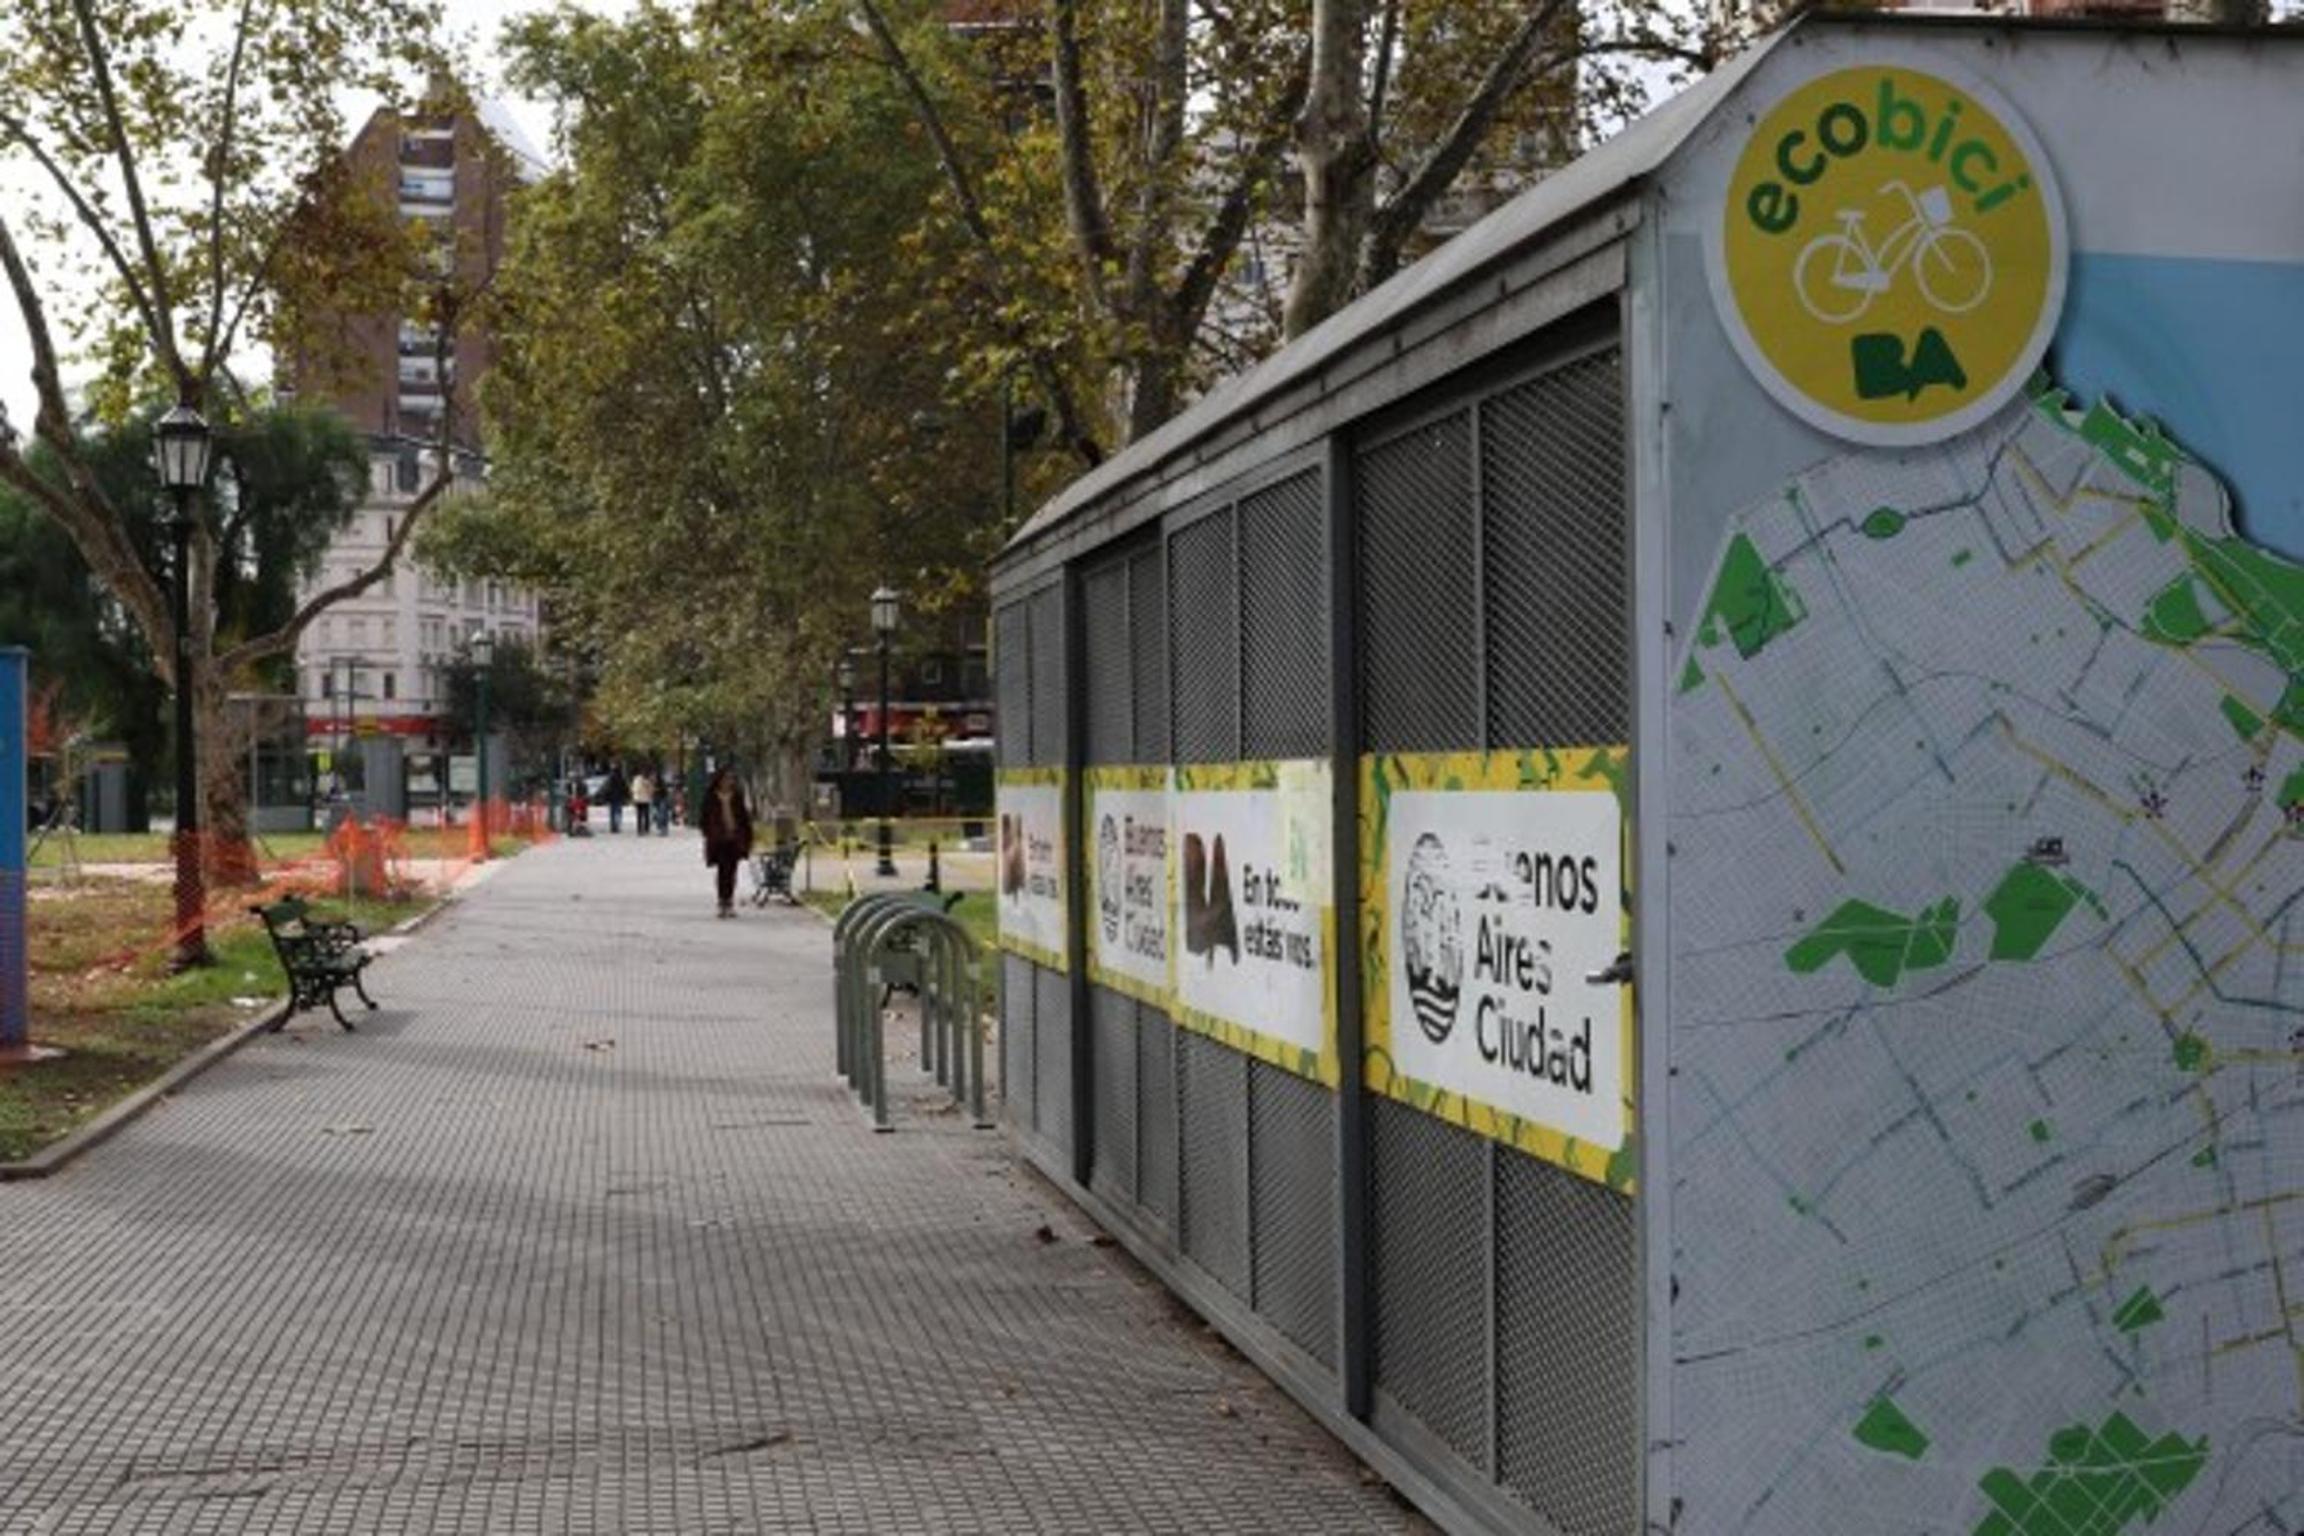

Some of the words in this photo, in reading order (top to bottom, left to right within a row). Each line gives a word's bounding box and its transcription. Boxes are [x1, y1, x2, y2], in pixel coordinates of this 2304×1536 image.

[1747, 78, 2030, 233] ecobici
[1851, 327, 1967, 403] BA
[1474, 914, 1552, 995] Aires
[1476, 995, 1593, 1093] Ciudad
